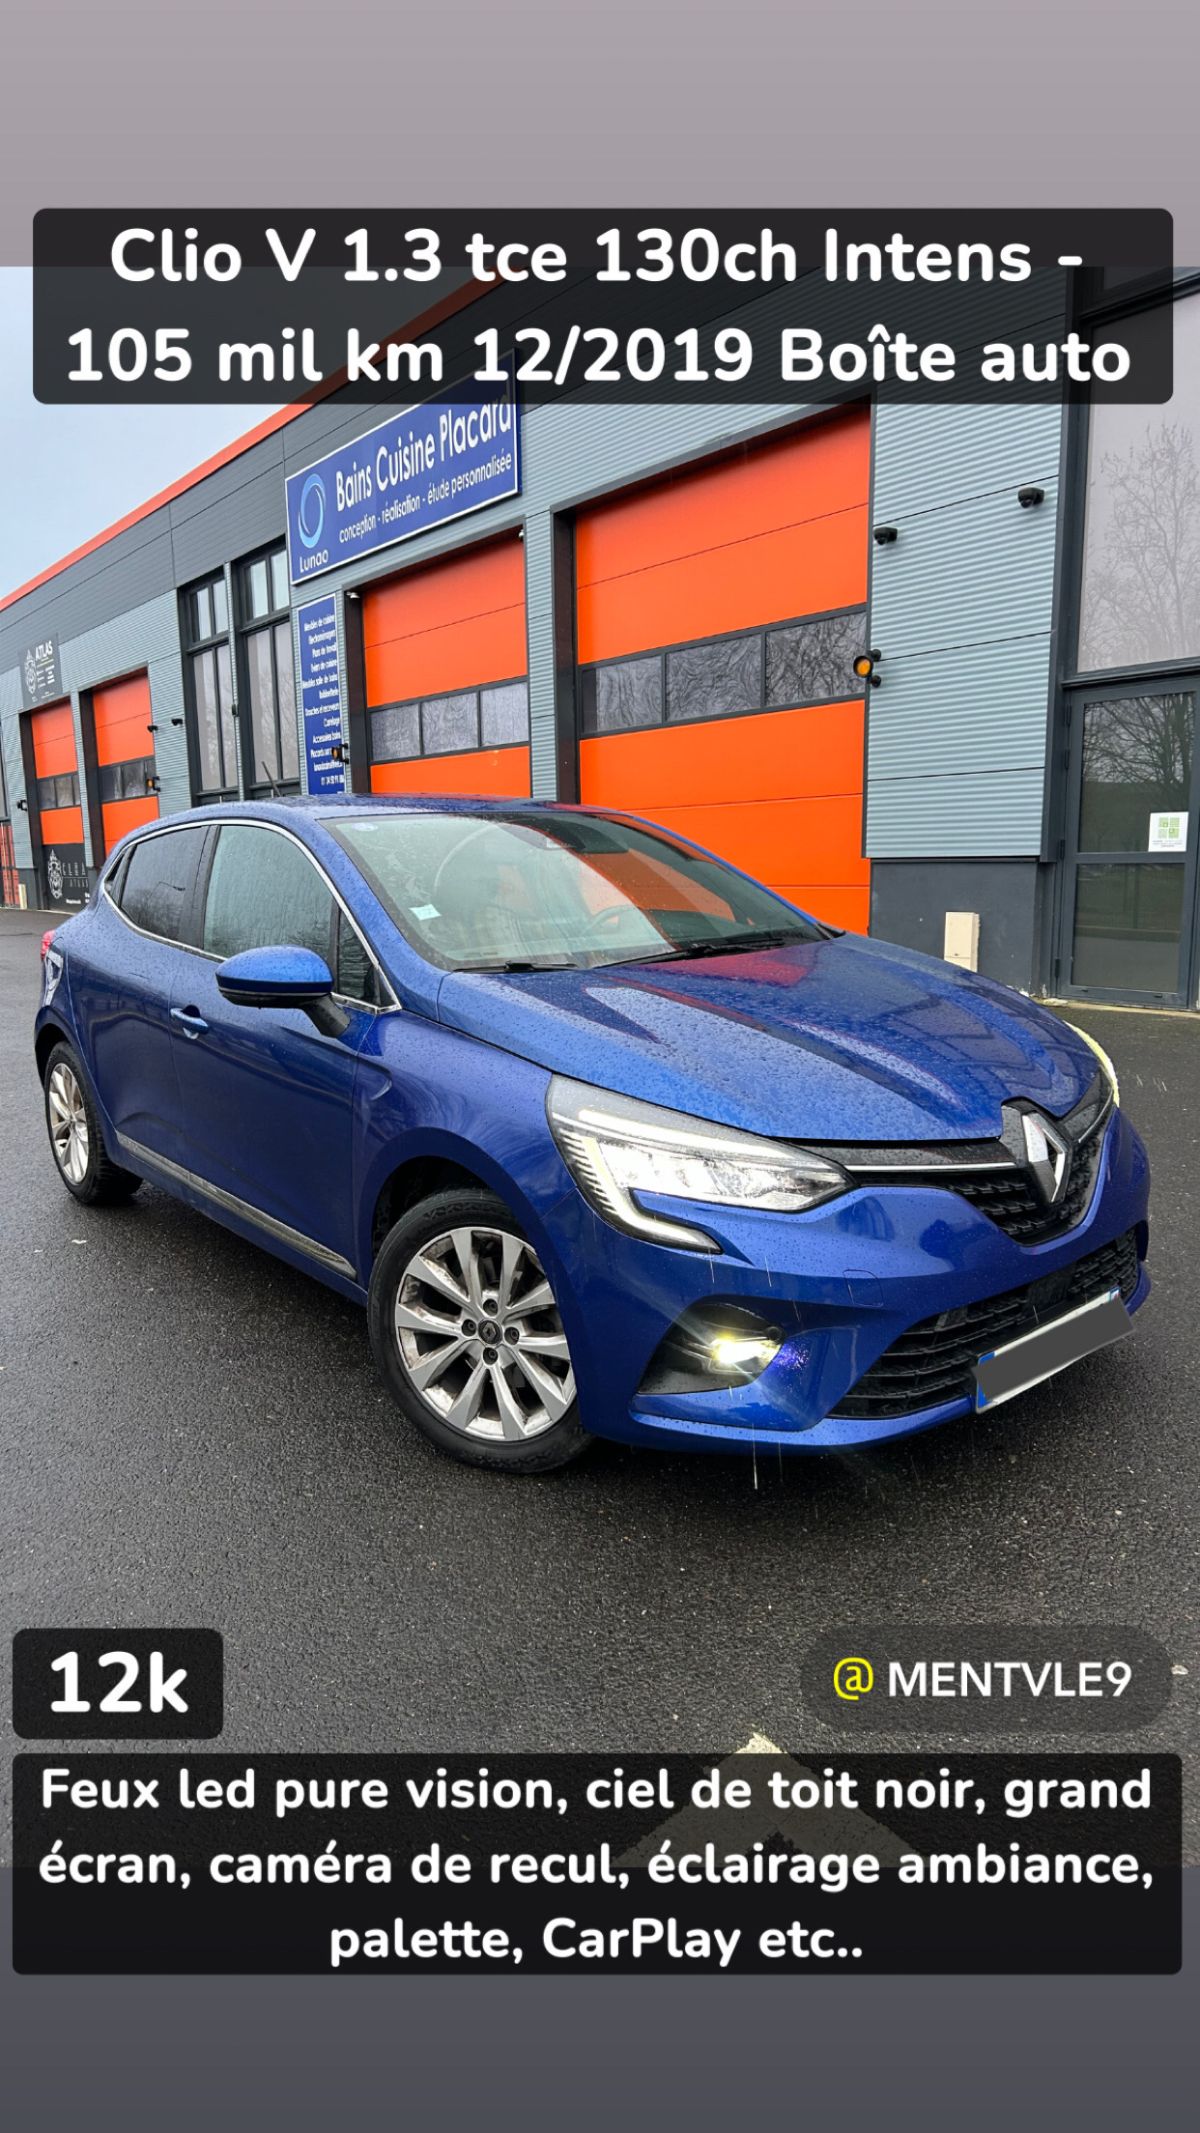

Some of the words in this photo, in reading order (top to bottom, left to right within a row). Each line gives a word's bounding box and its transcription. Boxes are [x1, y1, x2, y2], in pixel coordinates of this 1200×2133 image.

[335, 462, 373, 512] Bains
[376, 432, 436, 492] Cuisine
[439, 396, 512, 464] Placard
[339, 515, 376, 544] conception
[381, 495, 421, 525] réalisation
[427, 481, 450, 505] étude
[451, 448, 512, 499] personnalisée
[299, 548, 329, 573] Lunao
[35, 640, 53, 661] ATLAS
